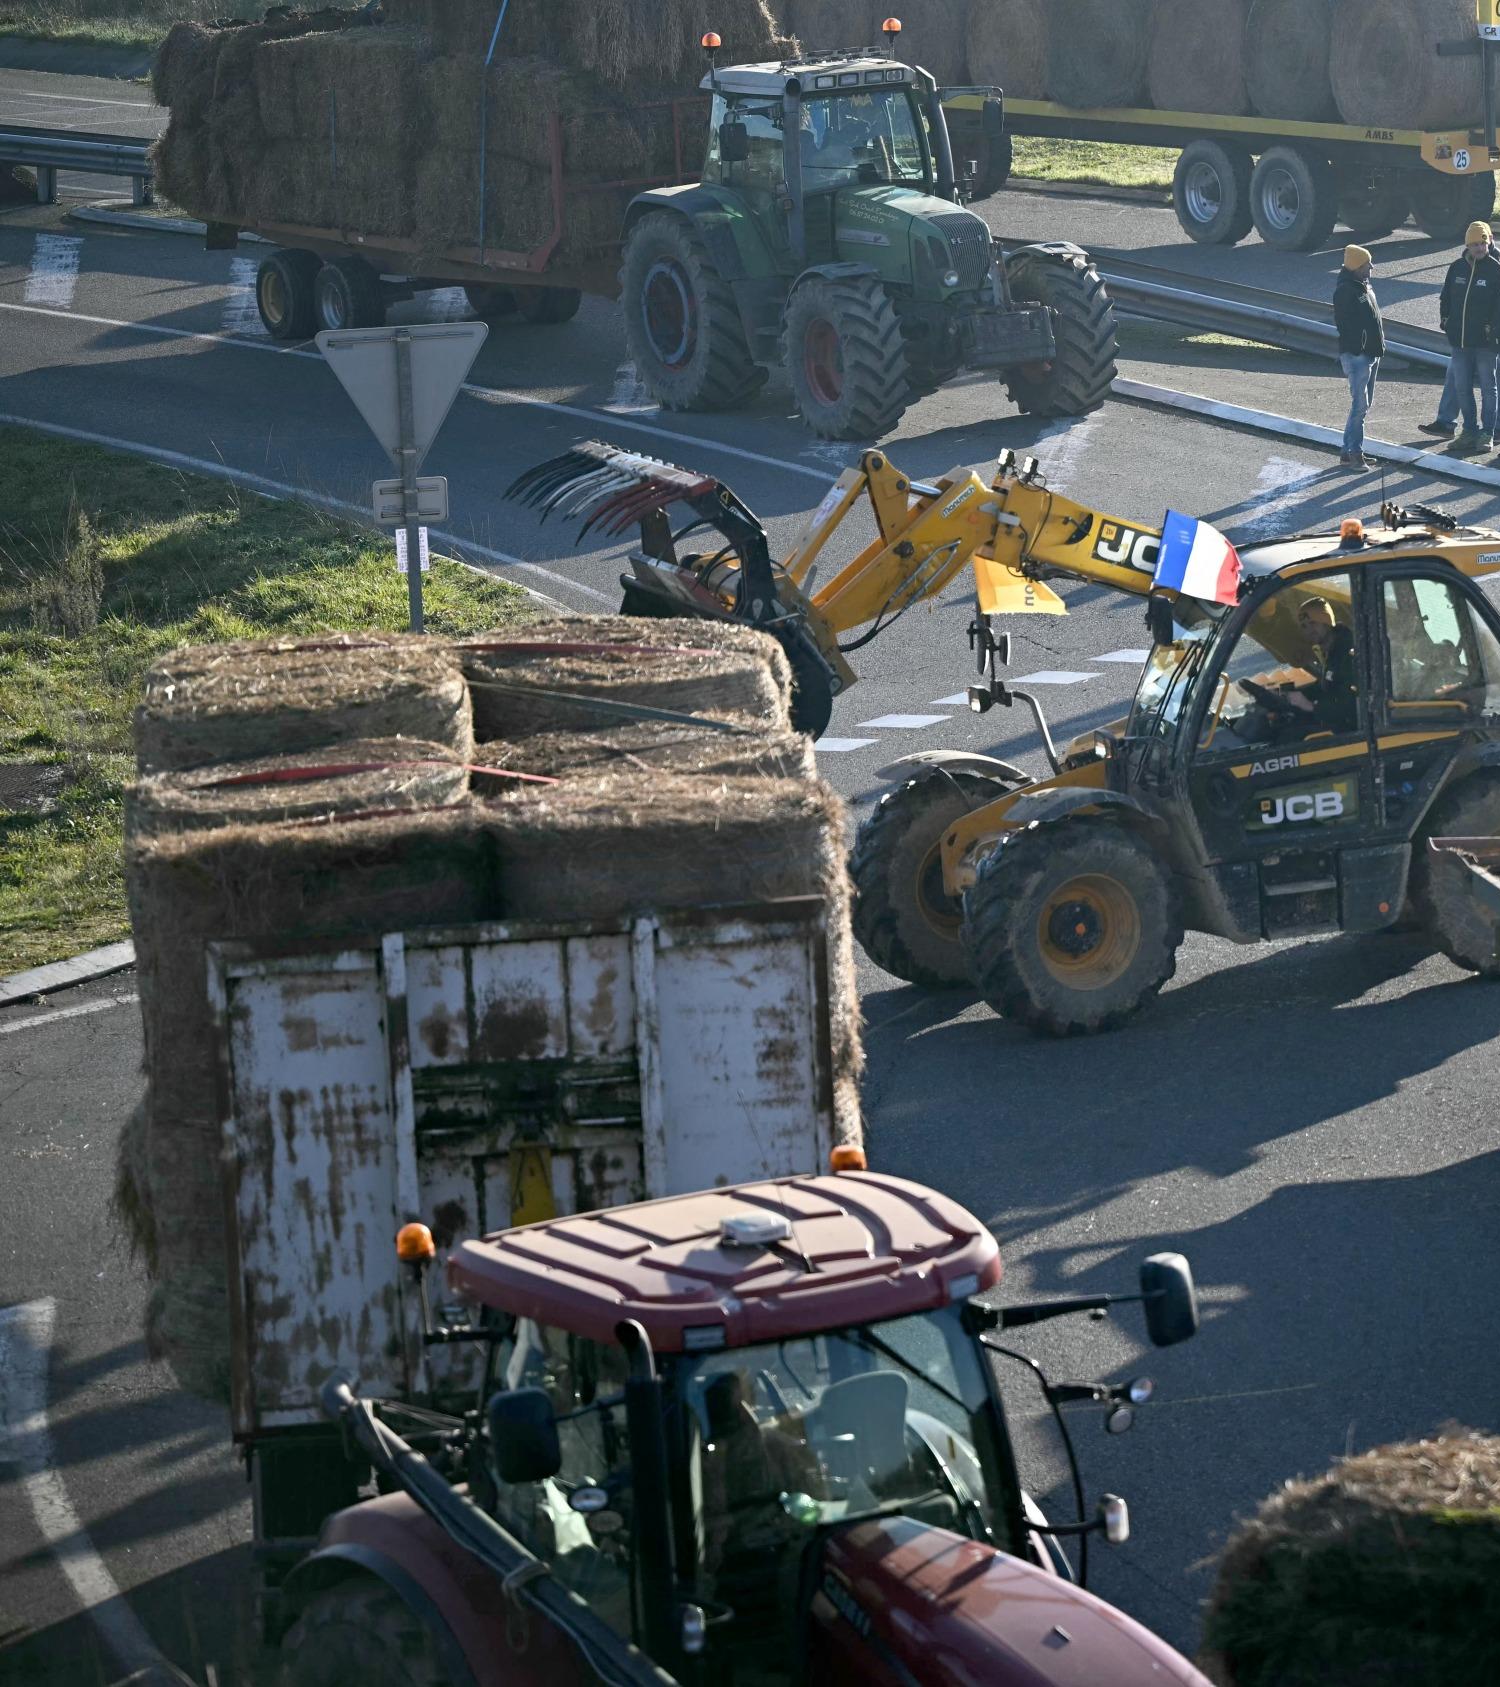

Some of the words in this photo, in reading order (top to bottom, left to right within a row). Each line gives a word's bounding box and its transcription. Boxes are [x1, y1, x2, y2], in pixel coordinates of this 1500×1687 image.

[1456, 151, 1467, 168] 25
[1097, 529, 1161, 573] JC
[1250, 754, 1299, 776] AGRI
[1261, 791, 1344, 825] JCB
